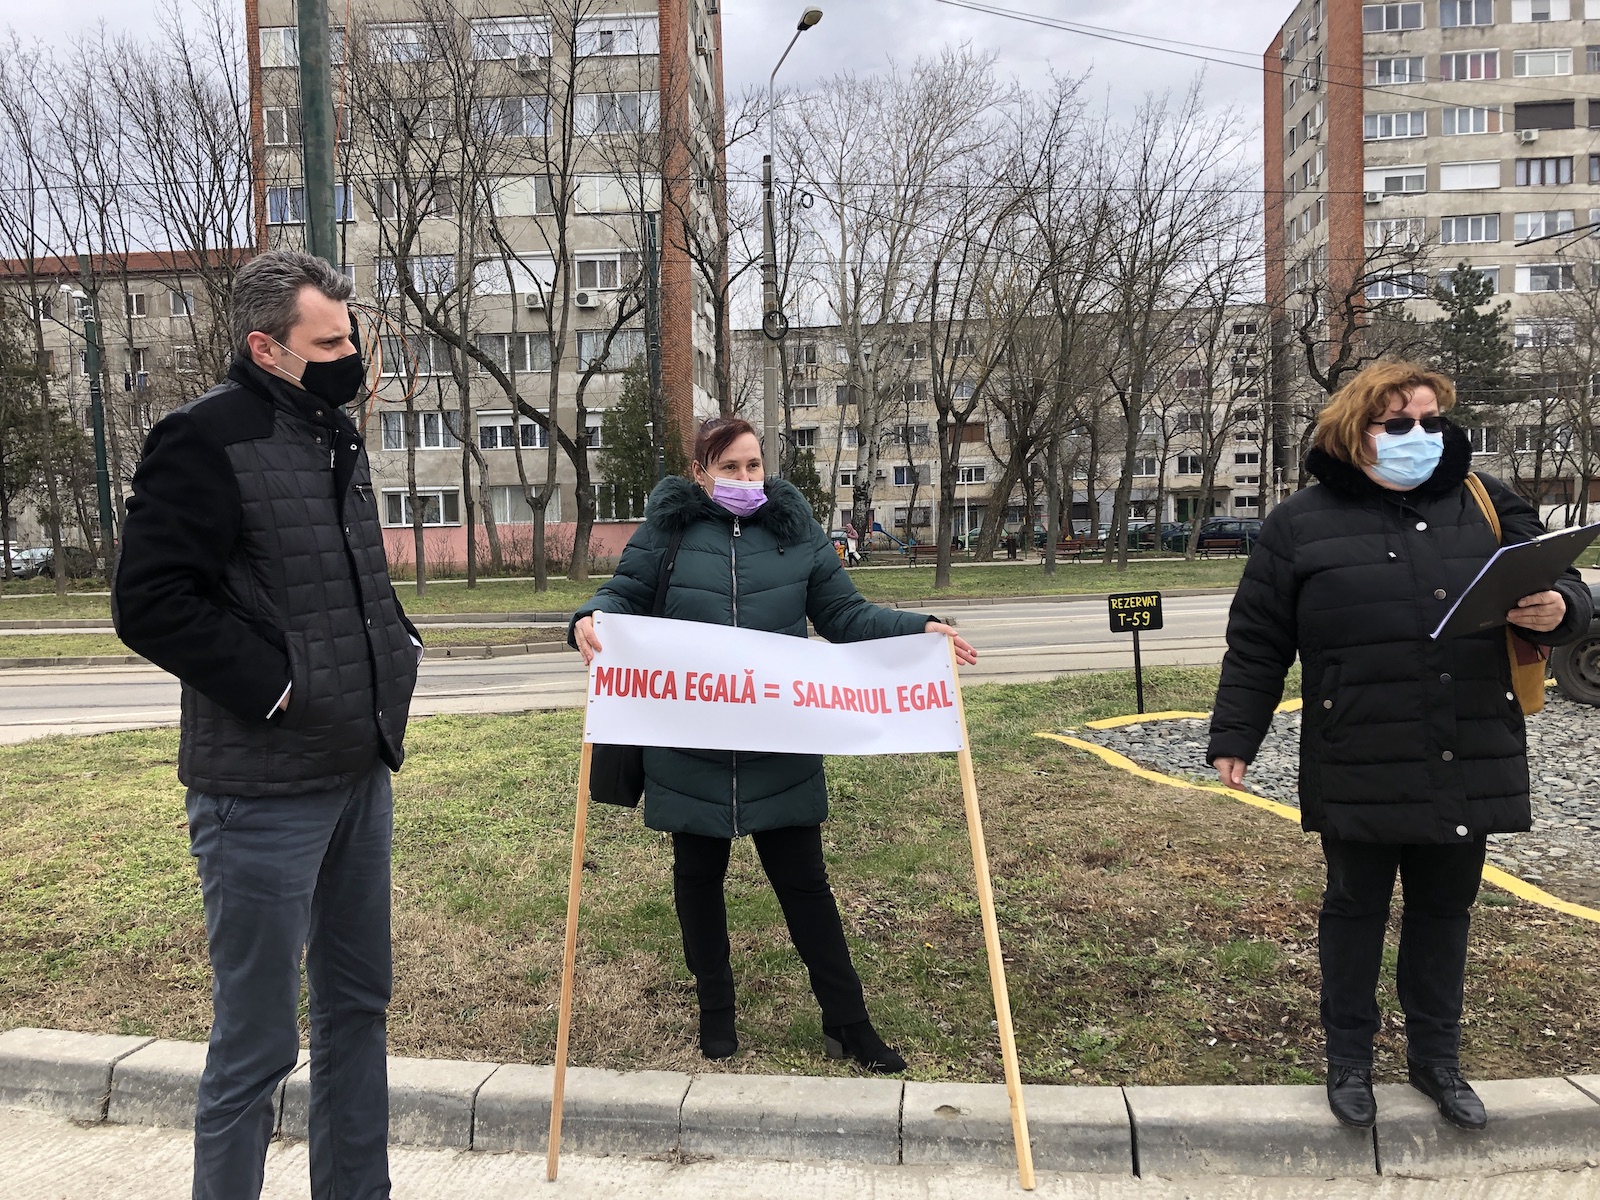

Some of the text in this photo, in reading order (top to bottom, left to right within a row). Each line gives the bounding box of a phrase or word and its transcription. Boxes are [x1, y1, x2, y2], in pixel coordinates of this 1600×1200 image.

[1111, 595, 1158, 609] REZERVAT
[1118, 611, 1151, 626] T-59
[595, 666, 953, 714] MUNCA EGALĂ = SALARIUL EGAL
